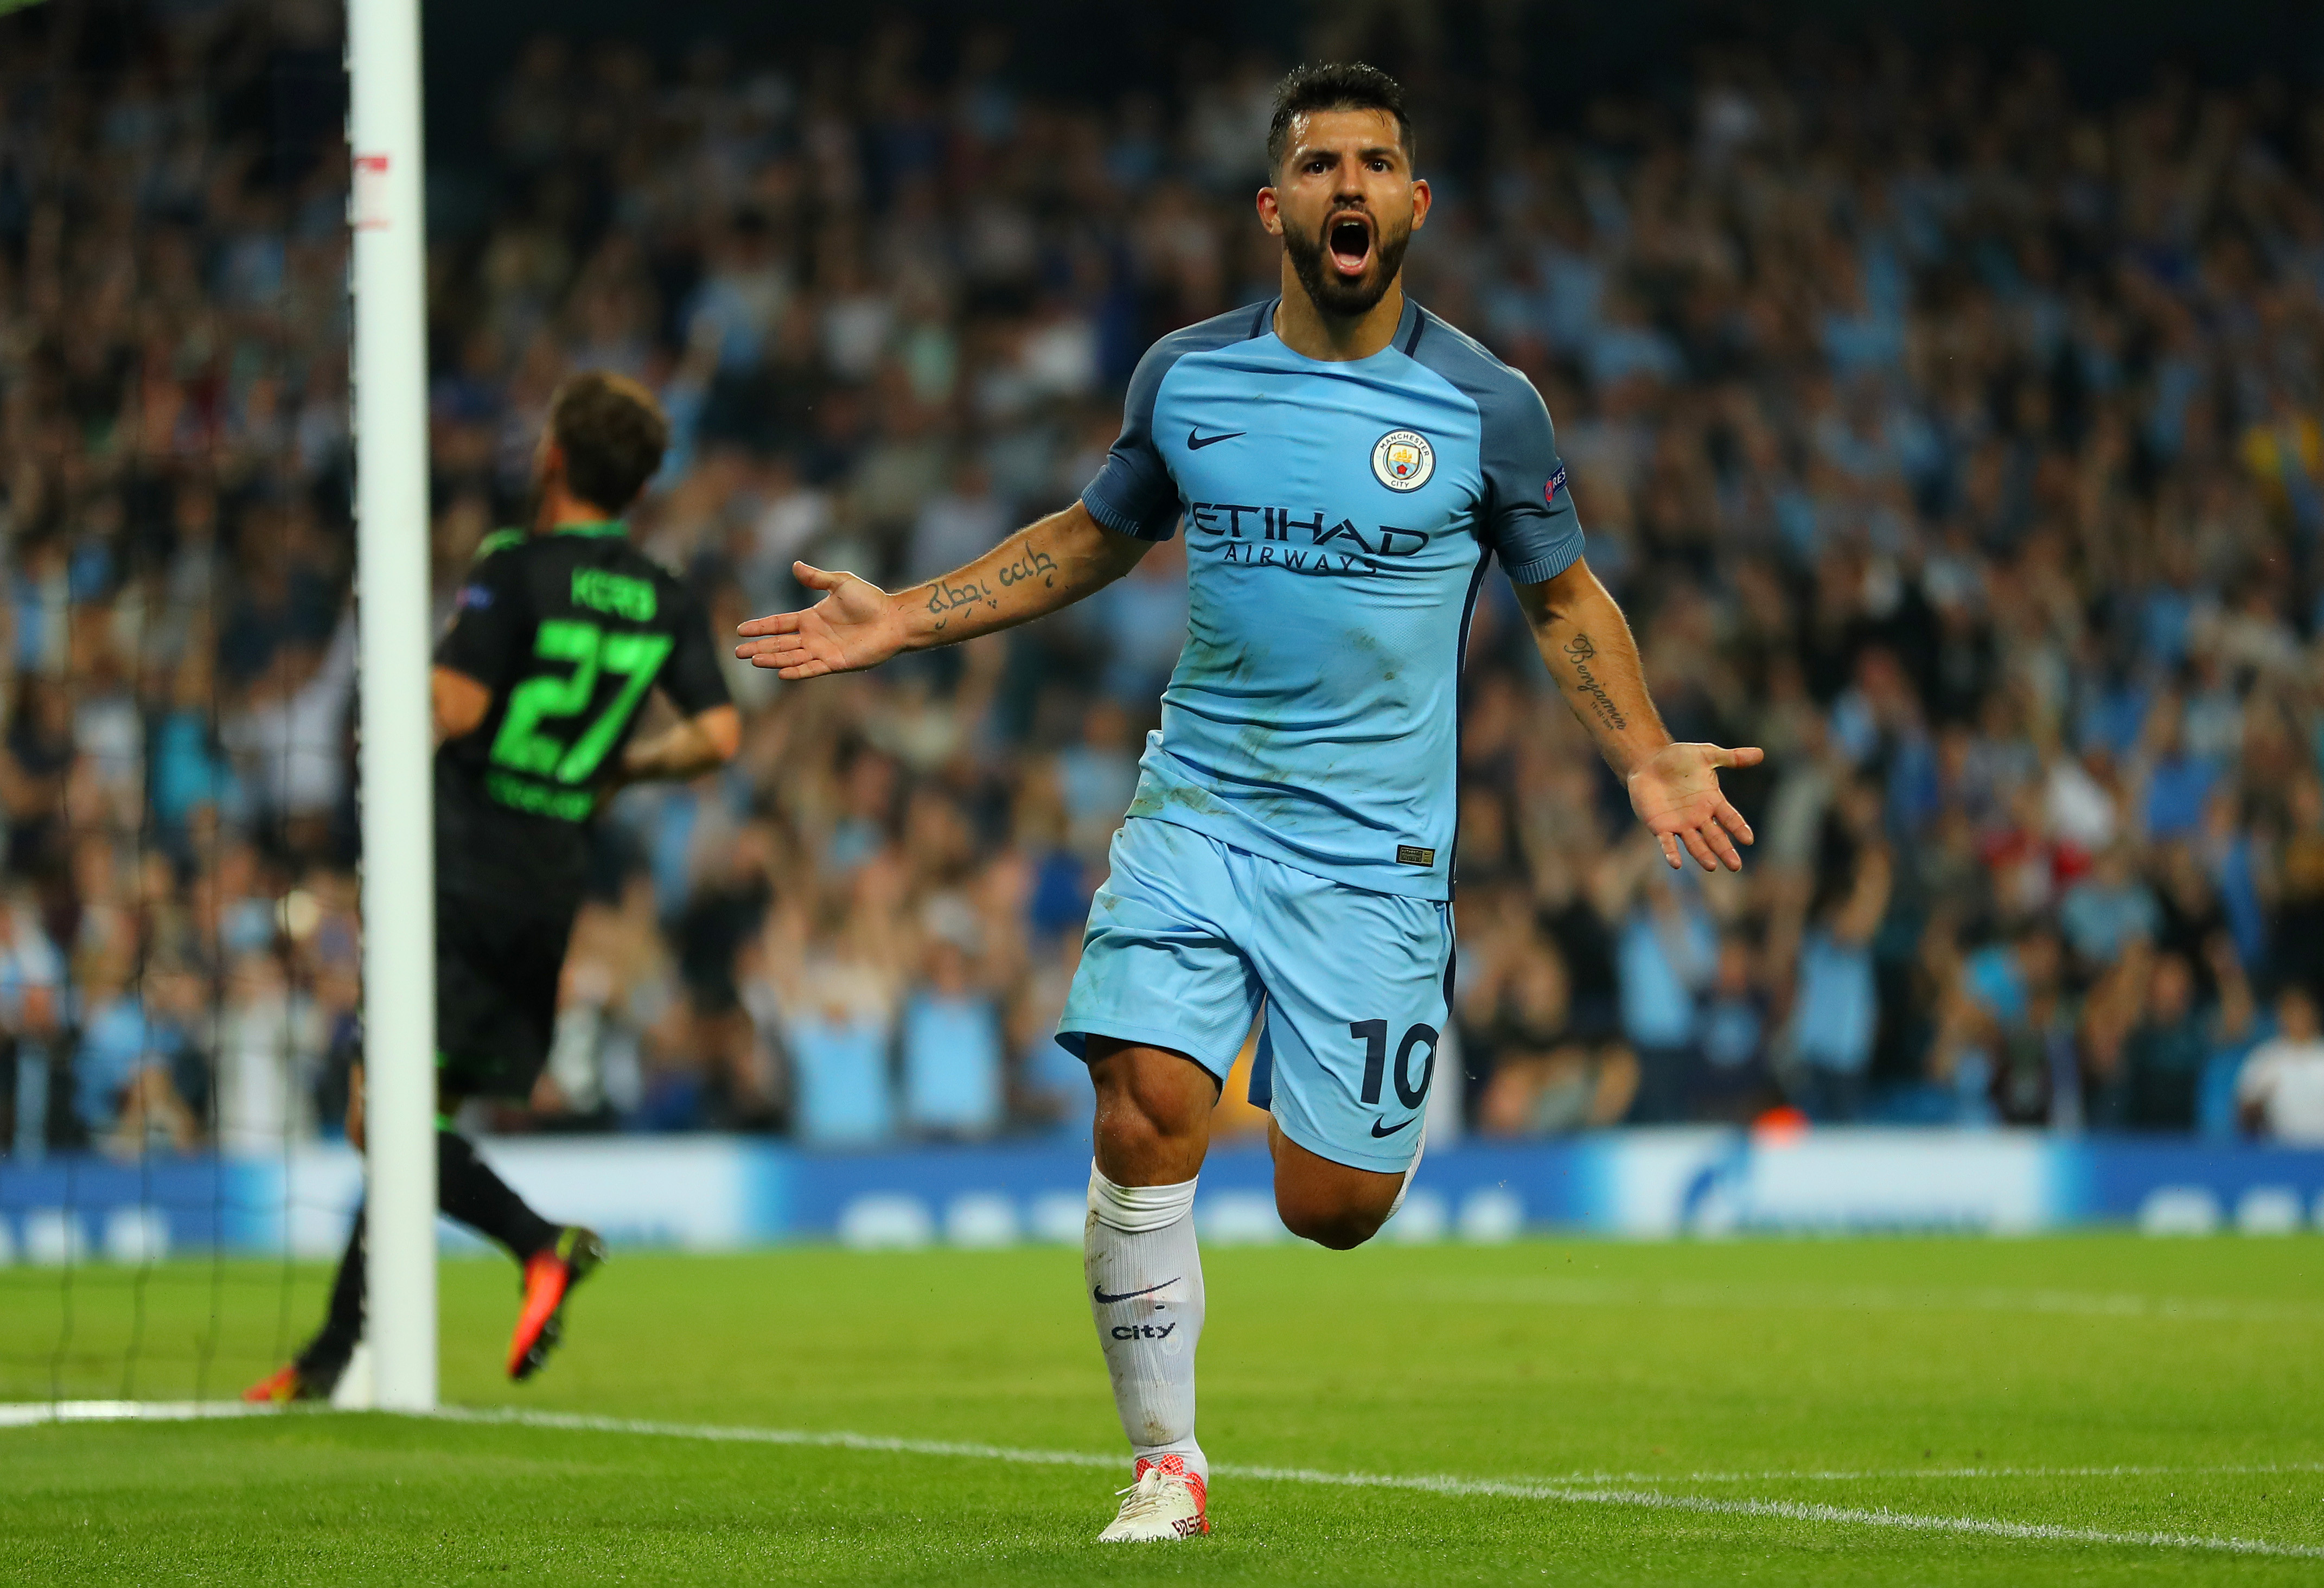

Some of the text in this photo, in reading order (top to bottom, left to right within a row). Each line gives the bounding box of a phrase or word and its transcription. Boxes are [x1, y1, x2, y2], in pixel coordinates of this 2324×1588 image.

[1380, 433, 1429, 457] MANCHESTER
[1390, 480, 1409, 488] CITY
[1193, 502, 1429, 556] ETIHAD
[1224, 544, 1376, 573] AIRWAYS
[489, 618, 674, 783] 27
[1563, 633, 1626, 730] Benjamin
[1349, 1019, 1439, 1109] 10
[1112, 1322, 1176, 1340] City
